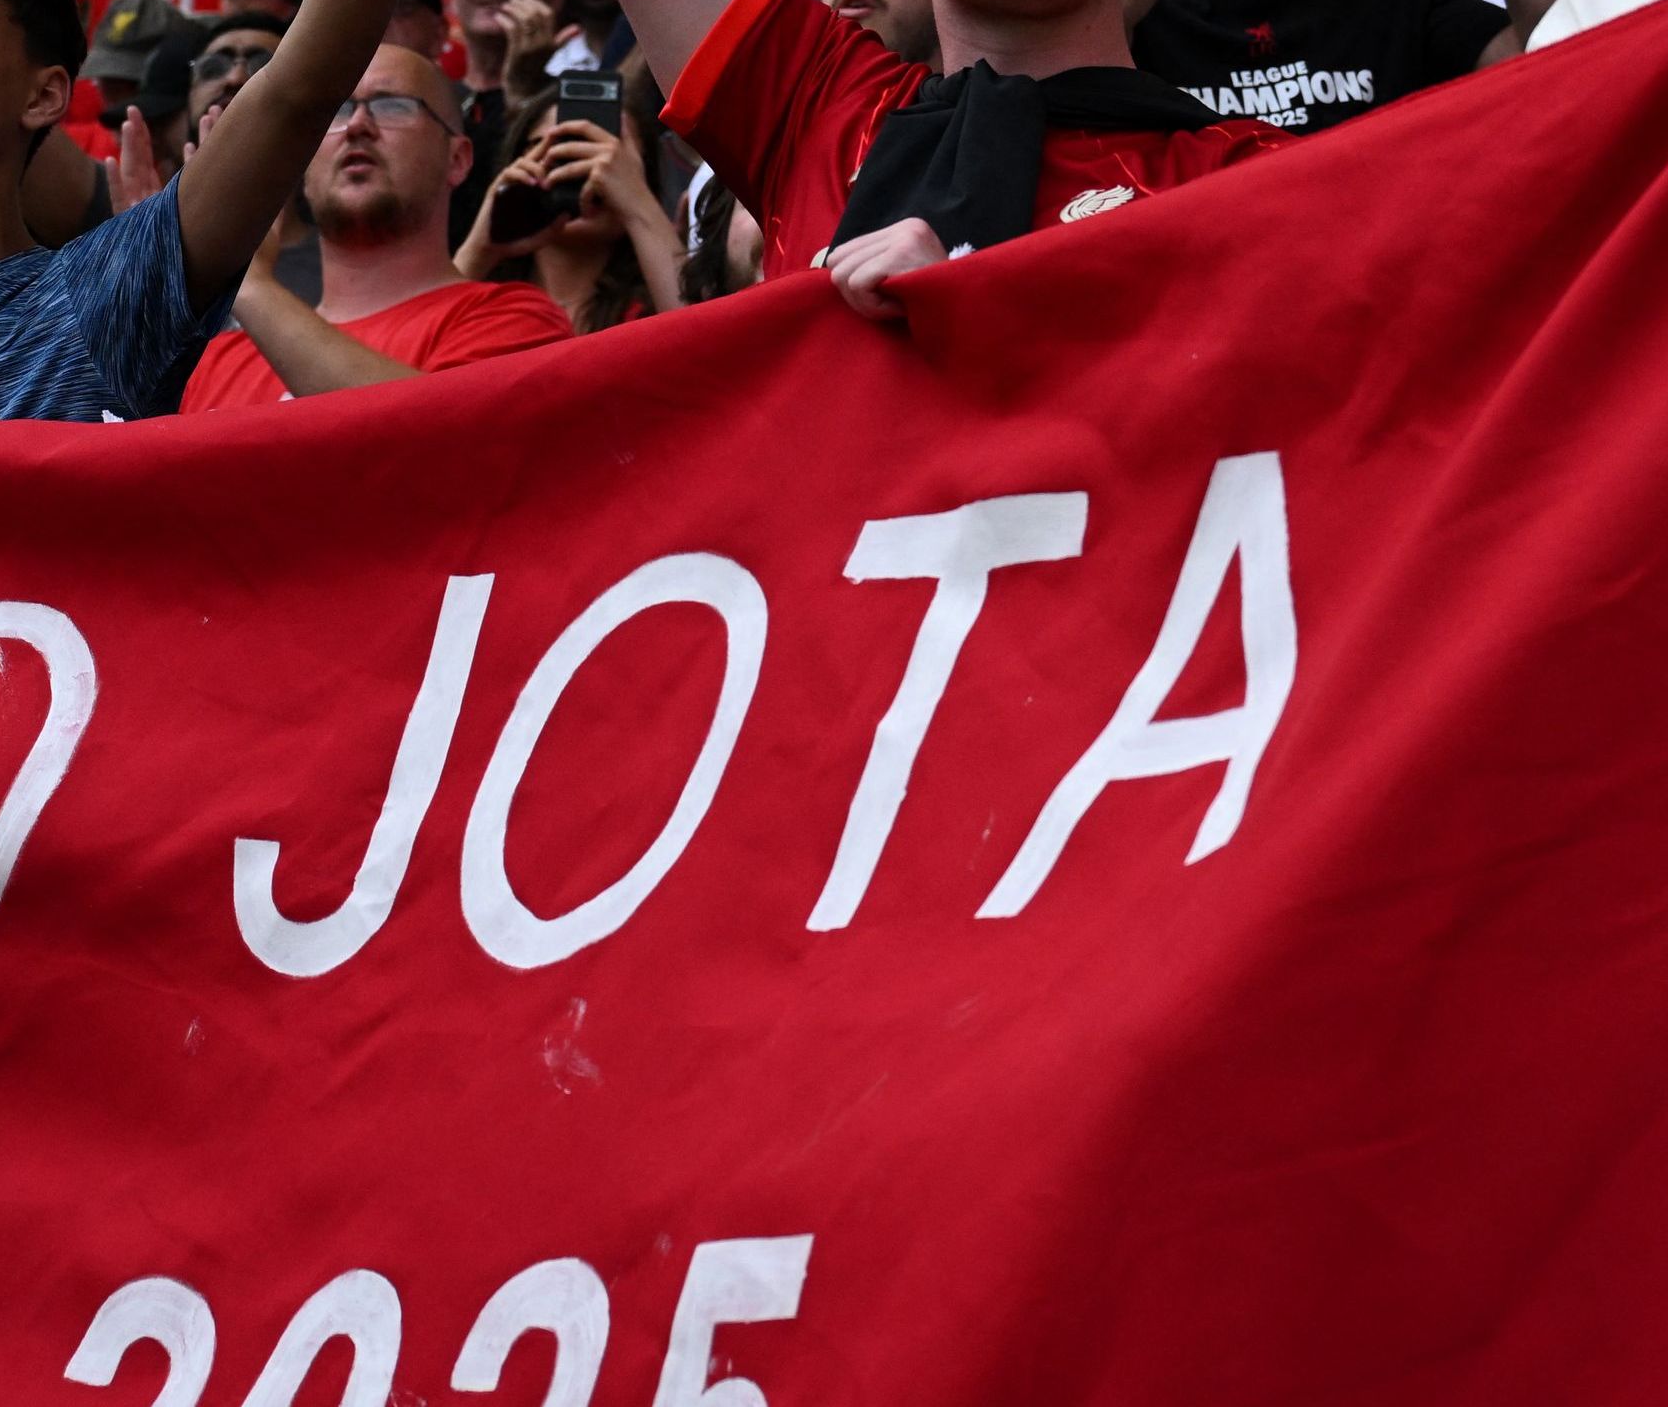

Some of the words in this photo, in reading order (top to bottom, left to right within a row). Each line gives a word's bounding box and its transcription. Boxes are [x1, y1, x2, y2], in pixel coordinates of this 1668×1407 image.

[1178, 69, 1374, 116] HAMPIONS
[1231, 60, 1308, 88] LEAGUE
[233, 450, 1298, 979] JOTA
